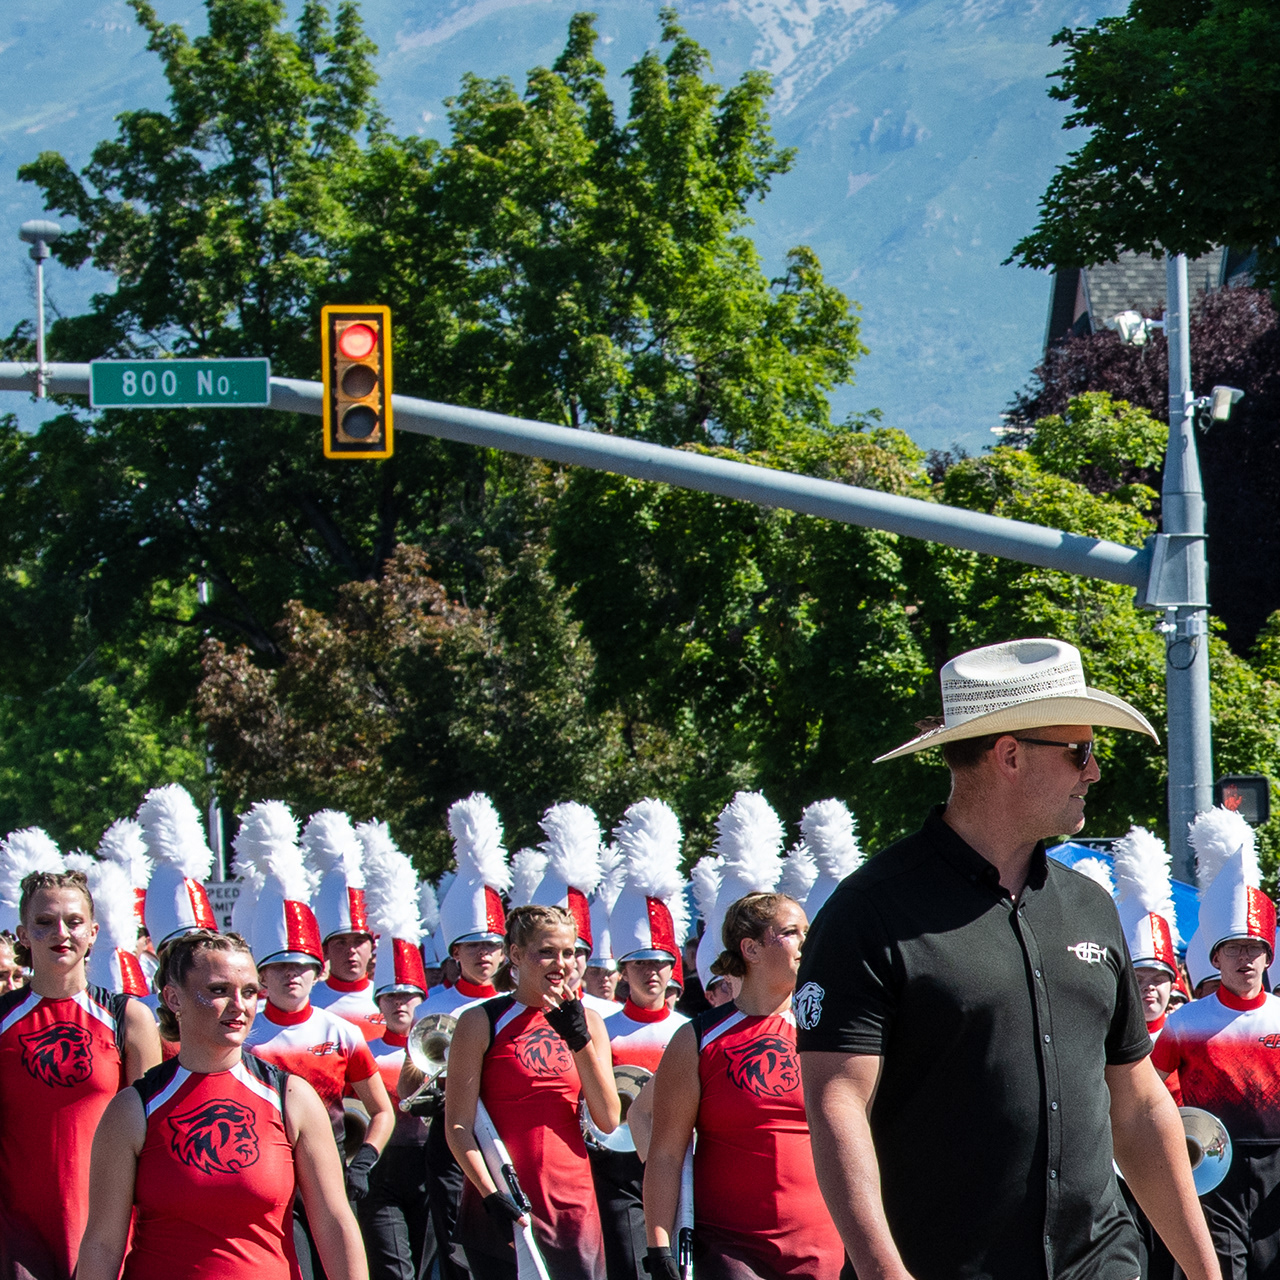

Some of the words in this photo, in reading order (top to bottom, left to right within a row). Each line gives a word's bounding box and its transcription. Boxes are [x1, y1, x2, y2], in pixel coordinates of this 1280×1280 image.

[122, 370, 177, 396] 800
[197, 370, 238, 396] No.
[206, 887, 240, 898] PEED
